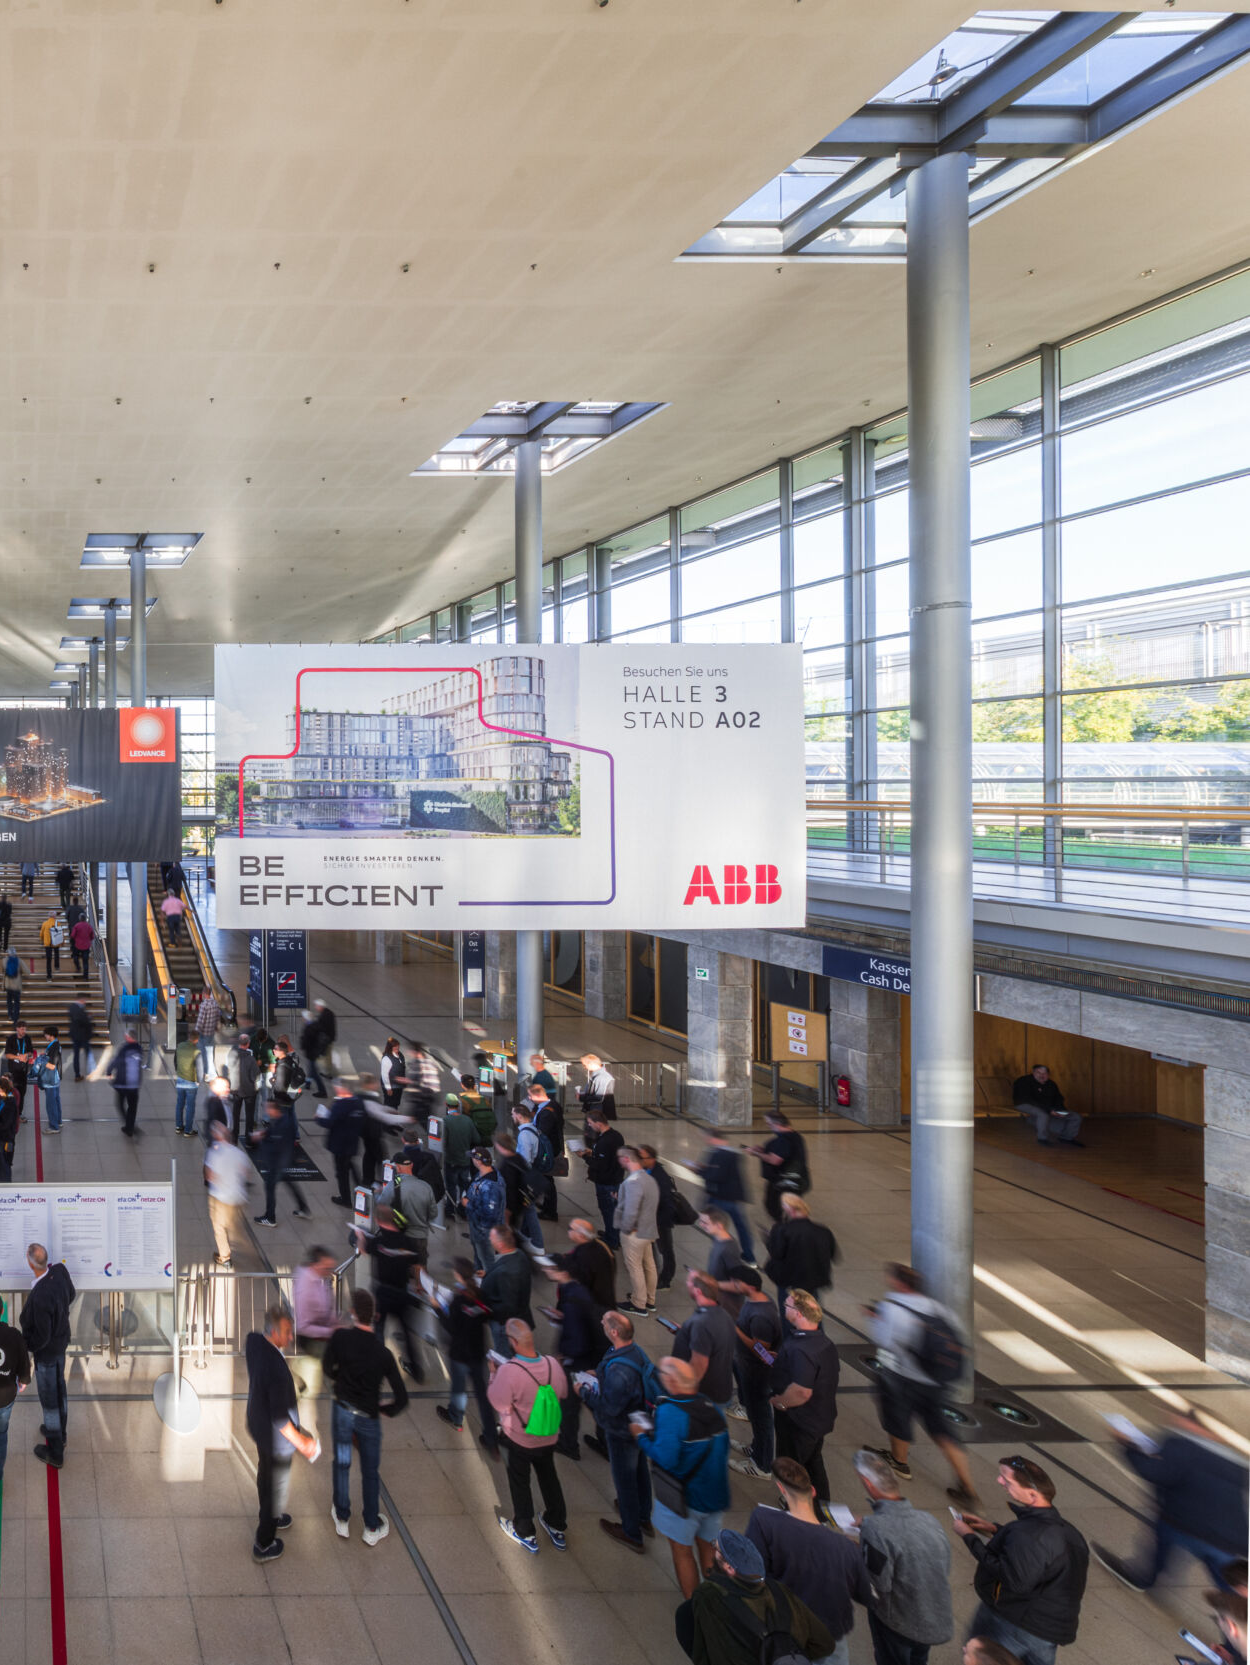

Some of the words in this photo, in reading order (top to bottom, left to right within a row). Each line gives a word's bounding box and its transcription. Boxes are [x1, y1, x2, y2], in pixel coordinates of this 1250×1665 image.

[623, 666, 682, 677] Besuchen
[685, 666, 703, 677] Sie
[707, 668, 728, 677] uns
[624, 685, 702, 703] HALLE
[715, 685, 727, 703] 3
[623, 711, 704, 729] STAND
[715, 711, 761, 729] A02
[239, 855, 285, 876] BE
[239, 884, 444, 906] EFFICIENT
[683, 864, 782, 905] ABB
[860, 971, 889, 988] Cash
[893, 978, 911, 992] De
